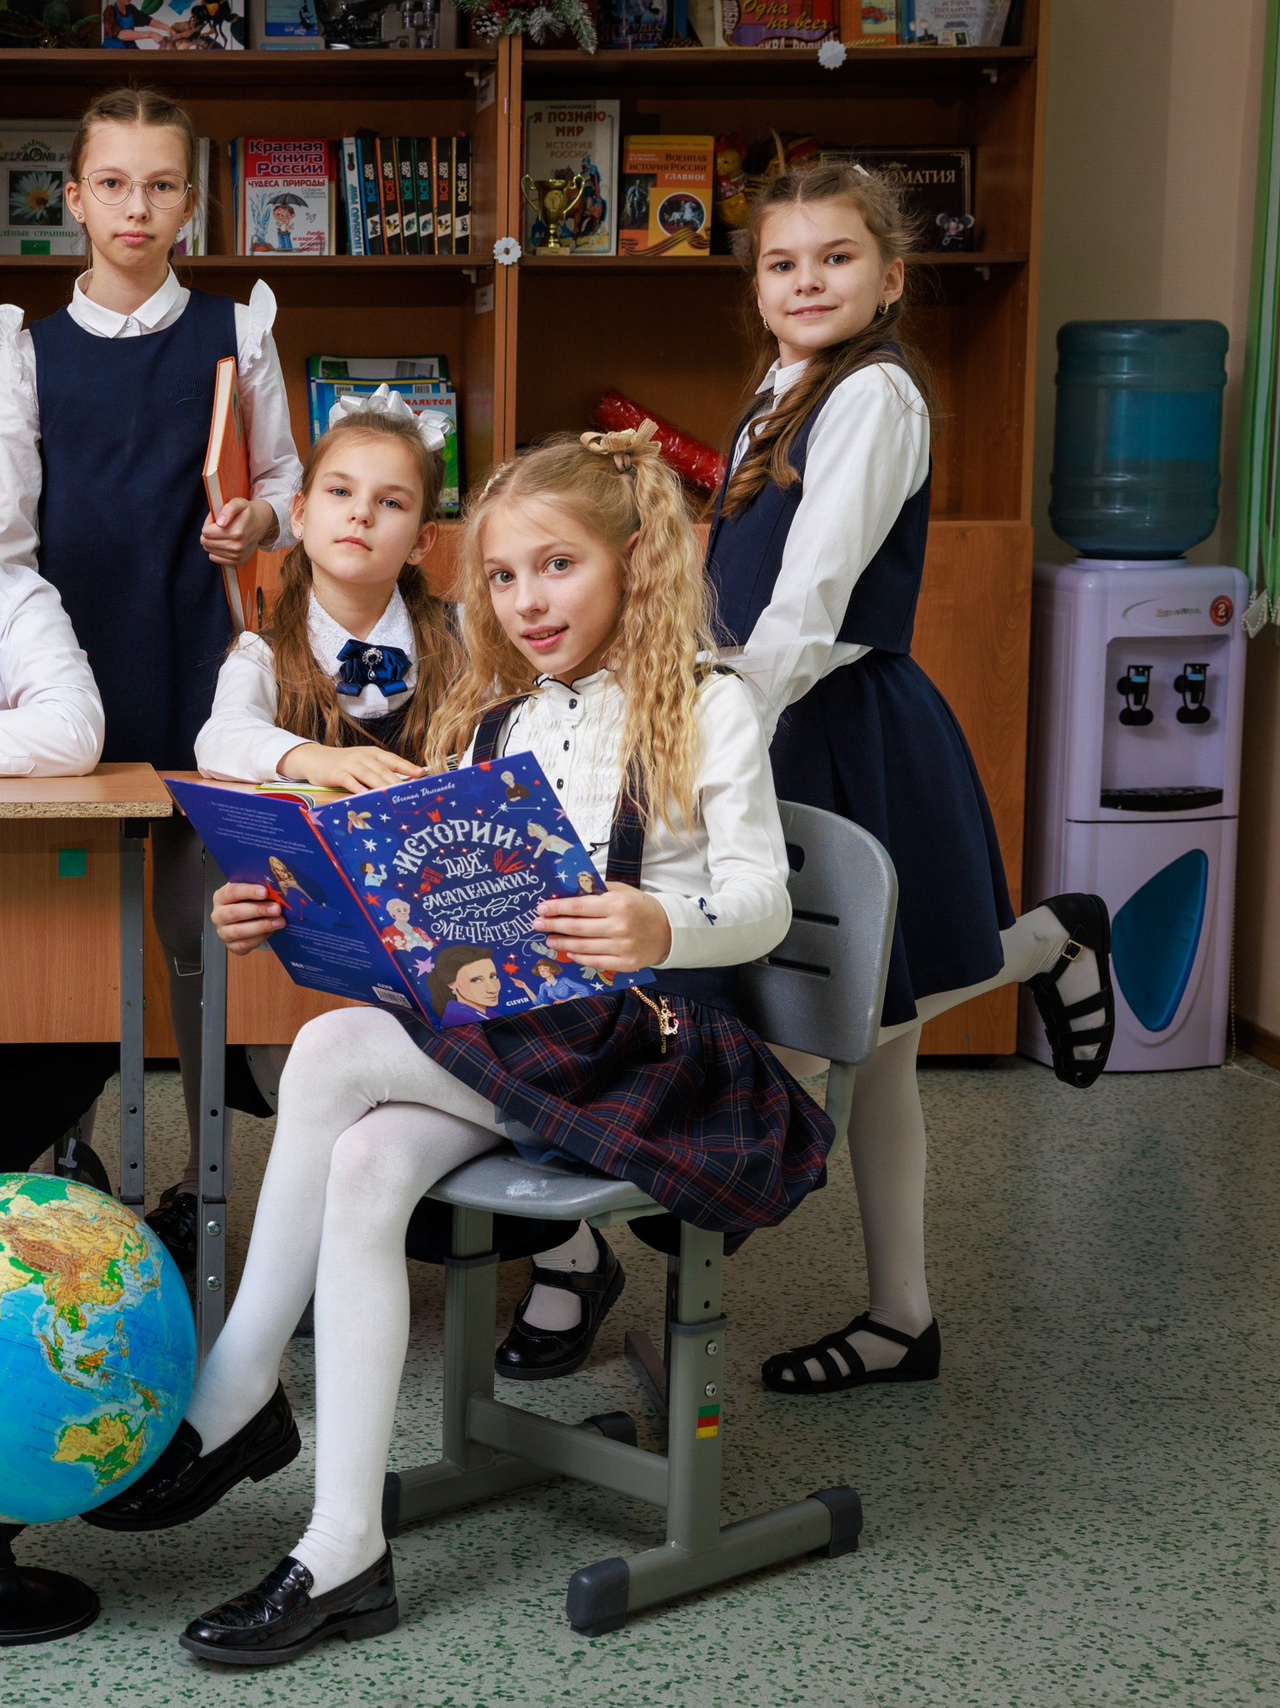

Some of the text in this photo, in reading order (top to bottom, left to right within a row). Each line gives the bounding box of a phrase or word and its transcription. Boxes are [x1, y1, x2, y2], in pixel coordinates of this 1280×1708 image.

[534, 111, 606, 124] Я ПОЗНАЮ
[556, 126, 584, 137] МИР
[249, 140, 324, 156] Красная
[545, 141, 592, 150] ИСТОРИЯ
[272, 153, 324, 164] книга
[256, 161, 325, 176] России
[665, 173, 707, 181] ГЛАВНОЕ
[248, 180, 279, 188] ЧУДЕСА
[348, 185, 362, 249] ПОЗНАЮ МИР
[1218, 604, 1226, 616] 2
[392, 793, 419, 804] Евгения
[392, 819, 517, 874] ИСТОРИИ
[442, 848, 486, 880] ДЛЯ
[422, 870, 539, 910] МАЛЕНЬКИХ
[506, 997, 530, 1007] CLEVER
